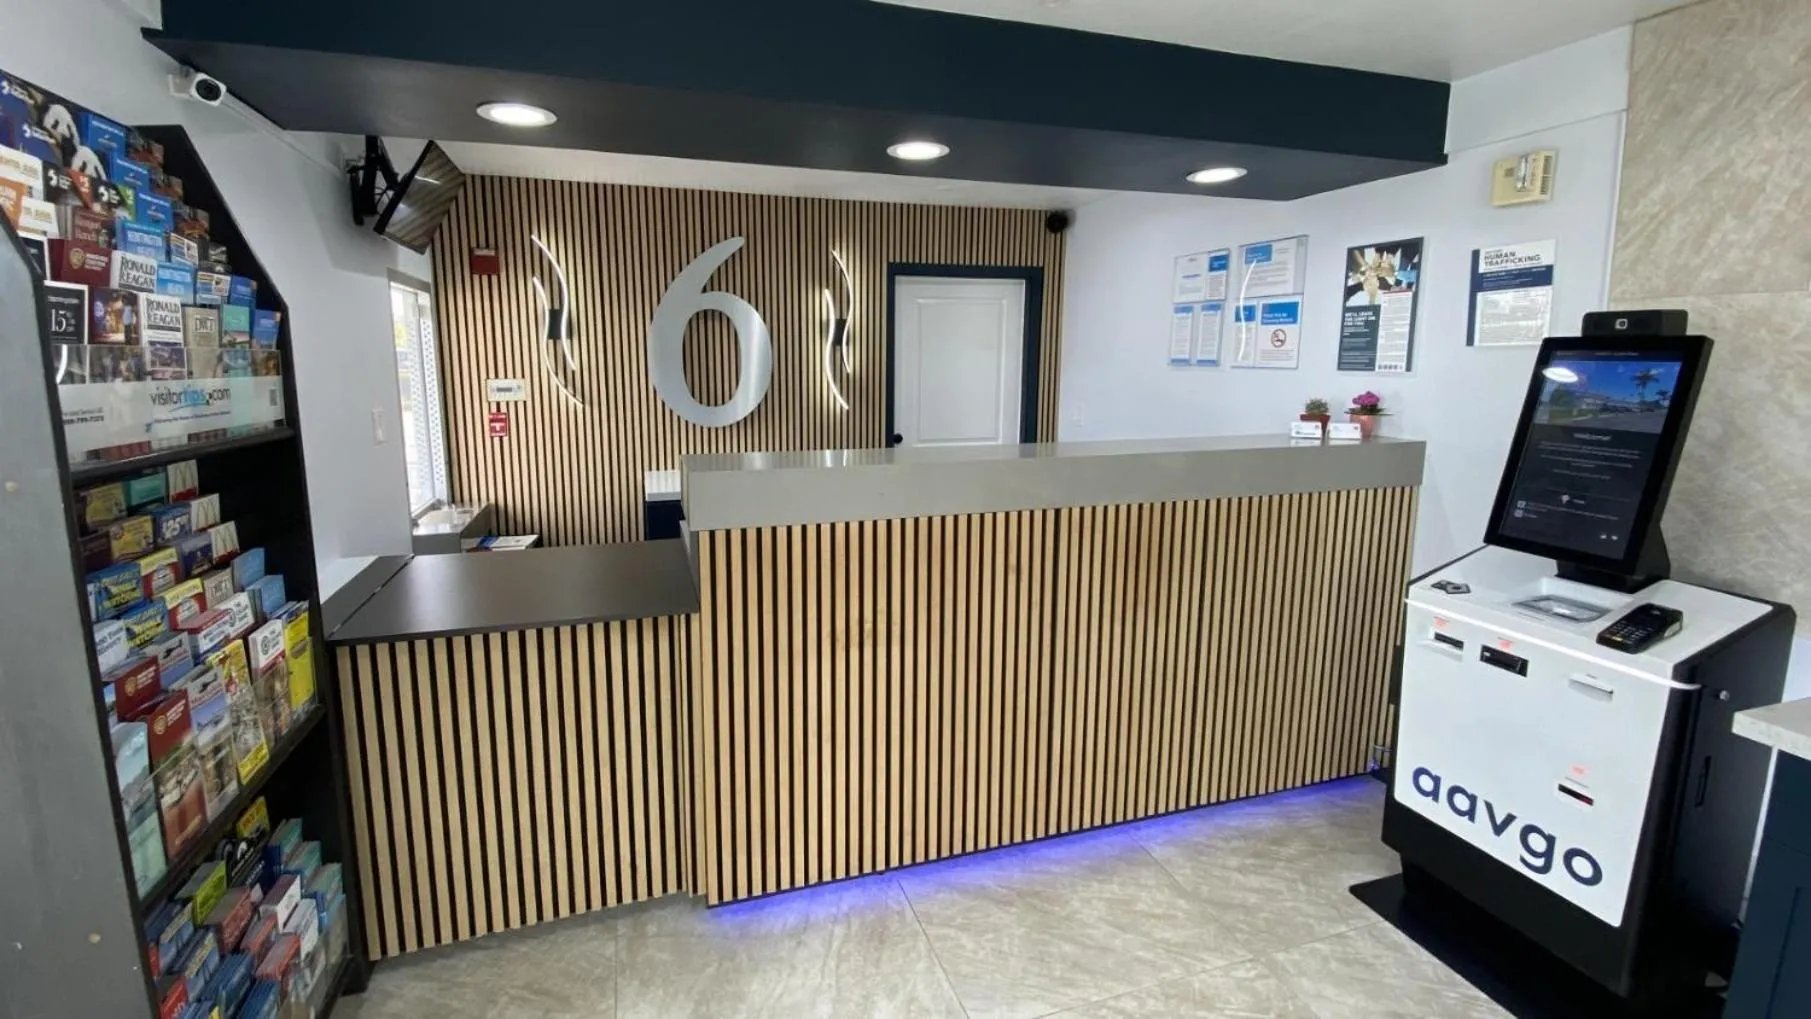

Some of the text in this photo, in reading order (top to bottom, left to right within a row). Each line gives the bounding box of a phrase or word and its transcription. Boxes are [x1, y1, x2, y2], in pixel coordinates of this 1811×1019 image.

[1484, 251, 1516, 261] HUMAN
[1484, 254, 1541, 267] TRAFFICKING
[120, 256, 156, 275] RONALD
[120, 271, 155, 287] REAGAN
[146, 298, 181, 313] RONALD
[147, 311, 182, 326] REAGAN
[646, 236, 773, 428] 6
[150, 385, 231, 406] visitortips.com
[1412, 767, 1603, 886] aavgo
